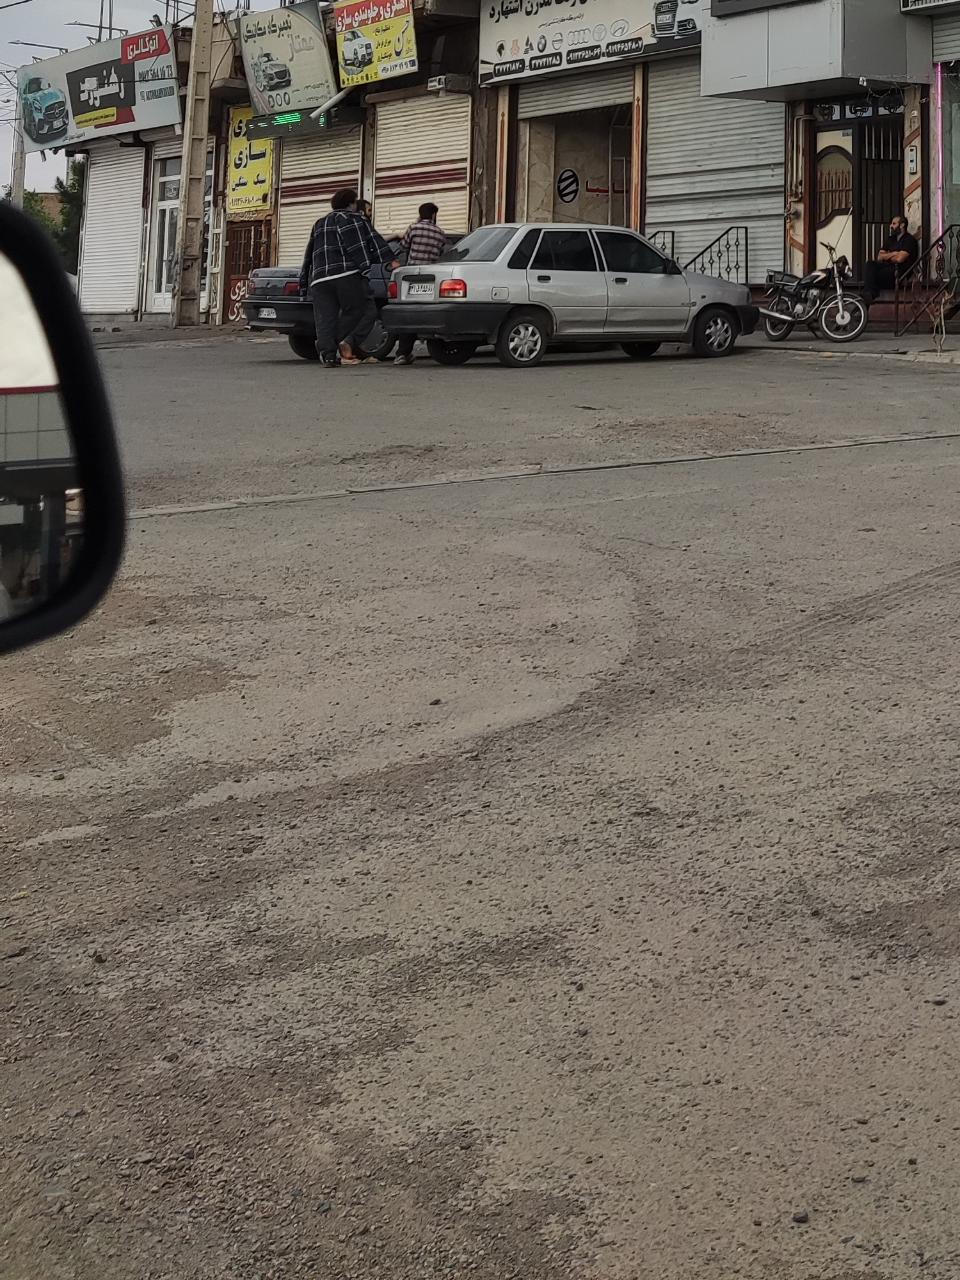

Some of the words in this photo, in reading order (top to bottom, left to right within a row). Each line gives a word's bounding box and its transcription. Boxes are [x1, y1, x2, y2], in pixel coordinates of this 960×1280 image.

[267, 13, 292, 38] تعمیرگاه
[335, 9, 352, 32] سازی
[353, 2, 379, 27] جلوبندی
[379, 7, 384, 20] و
[287, 34, 314, 62] ممتاز
[234, 142, 267, 169] سازی
[230, 279, 249, 301] اطری
